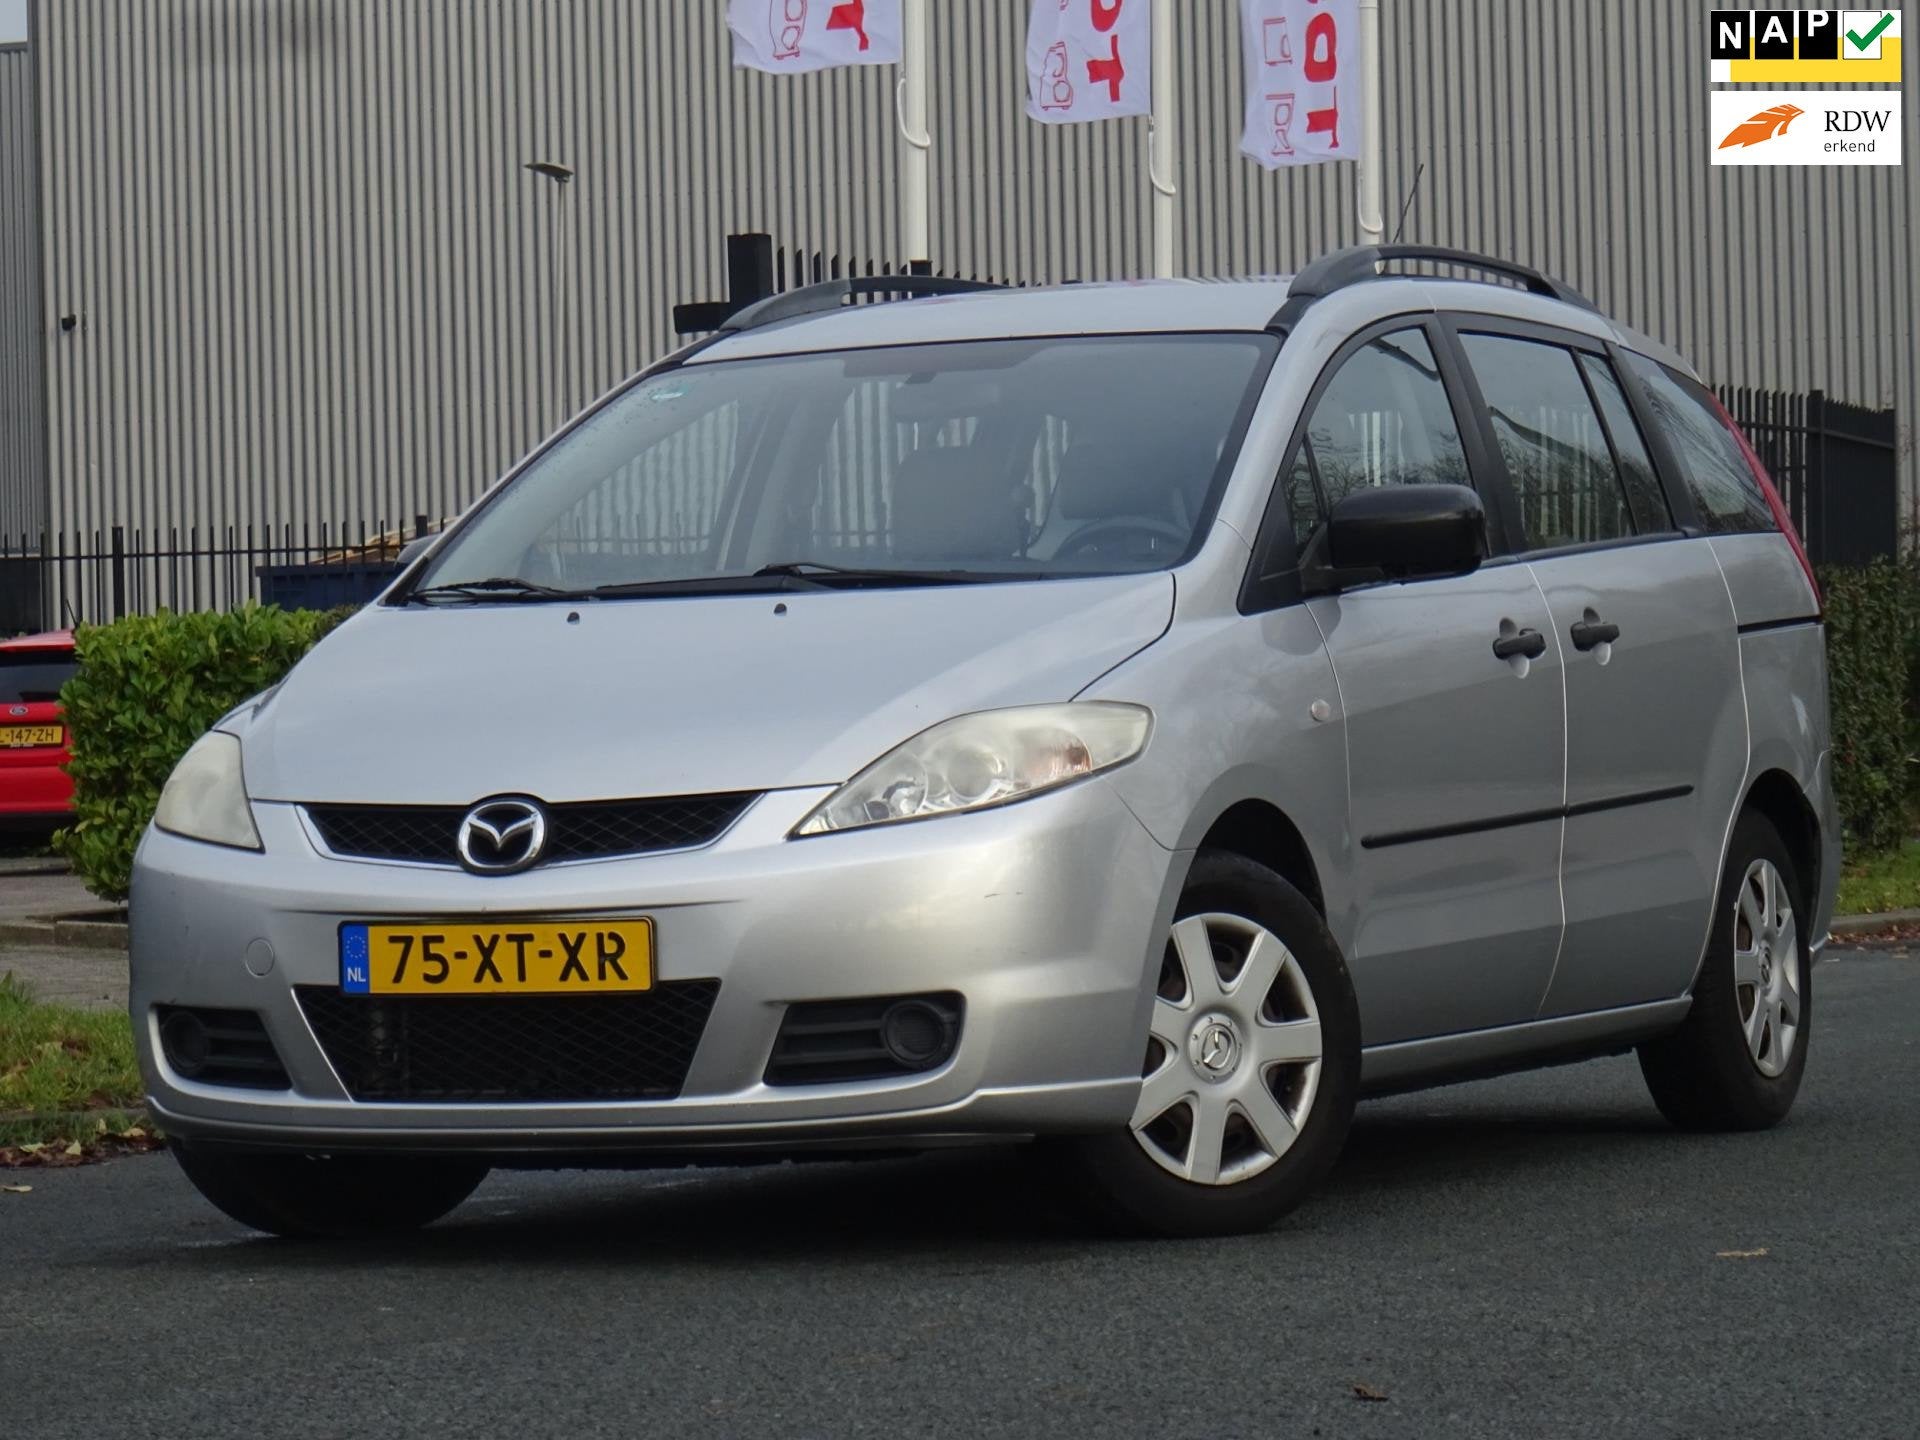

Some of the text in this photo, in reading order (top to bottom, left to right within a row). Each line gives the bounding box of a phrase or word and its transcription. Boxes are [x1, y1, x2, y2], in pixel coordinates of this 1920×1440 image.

[1304, 0, 1340, 149] OT
[347, 967, 366, 983] NL
[388, 932, 629, 984] 75-XT-XR
